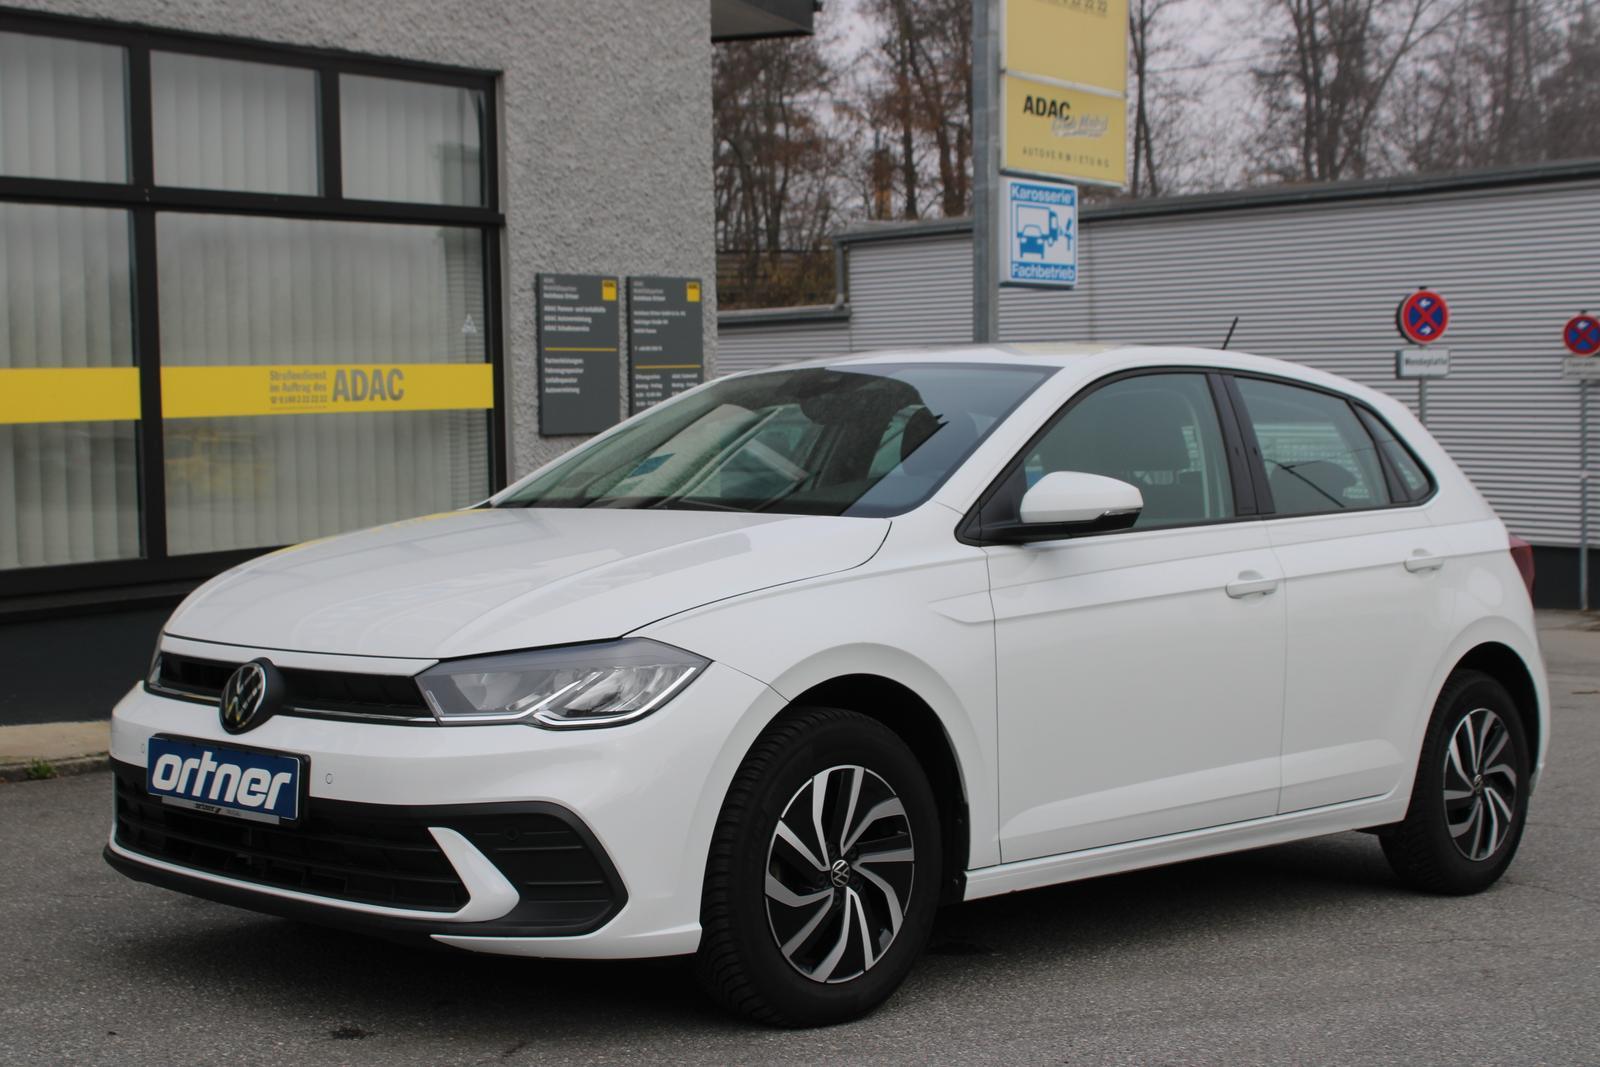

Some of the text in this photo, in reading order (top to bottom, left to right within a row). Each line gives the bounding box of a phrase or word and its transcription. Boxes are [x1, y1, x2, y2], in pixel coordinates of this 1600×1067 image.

[1023, 95, 1071, 121] ADAC
[1022, 146, 1110, 168] AUTOVERMIETUNG
[1012, 185, 1073, 205] Karosserie
[1012, 263, 1074, 280] Fachbetrieb
[332, 368, 405, 402] ADAC
[152, 751, 292, 810] ortner
